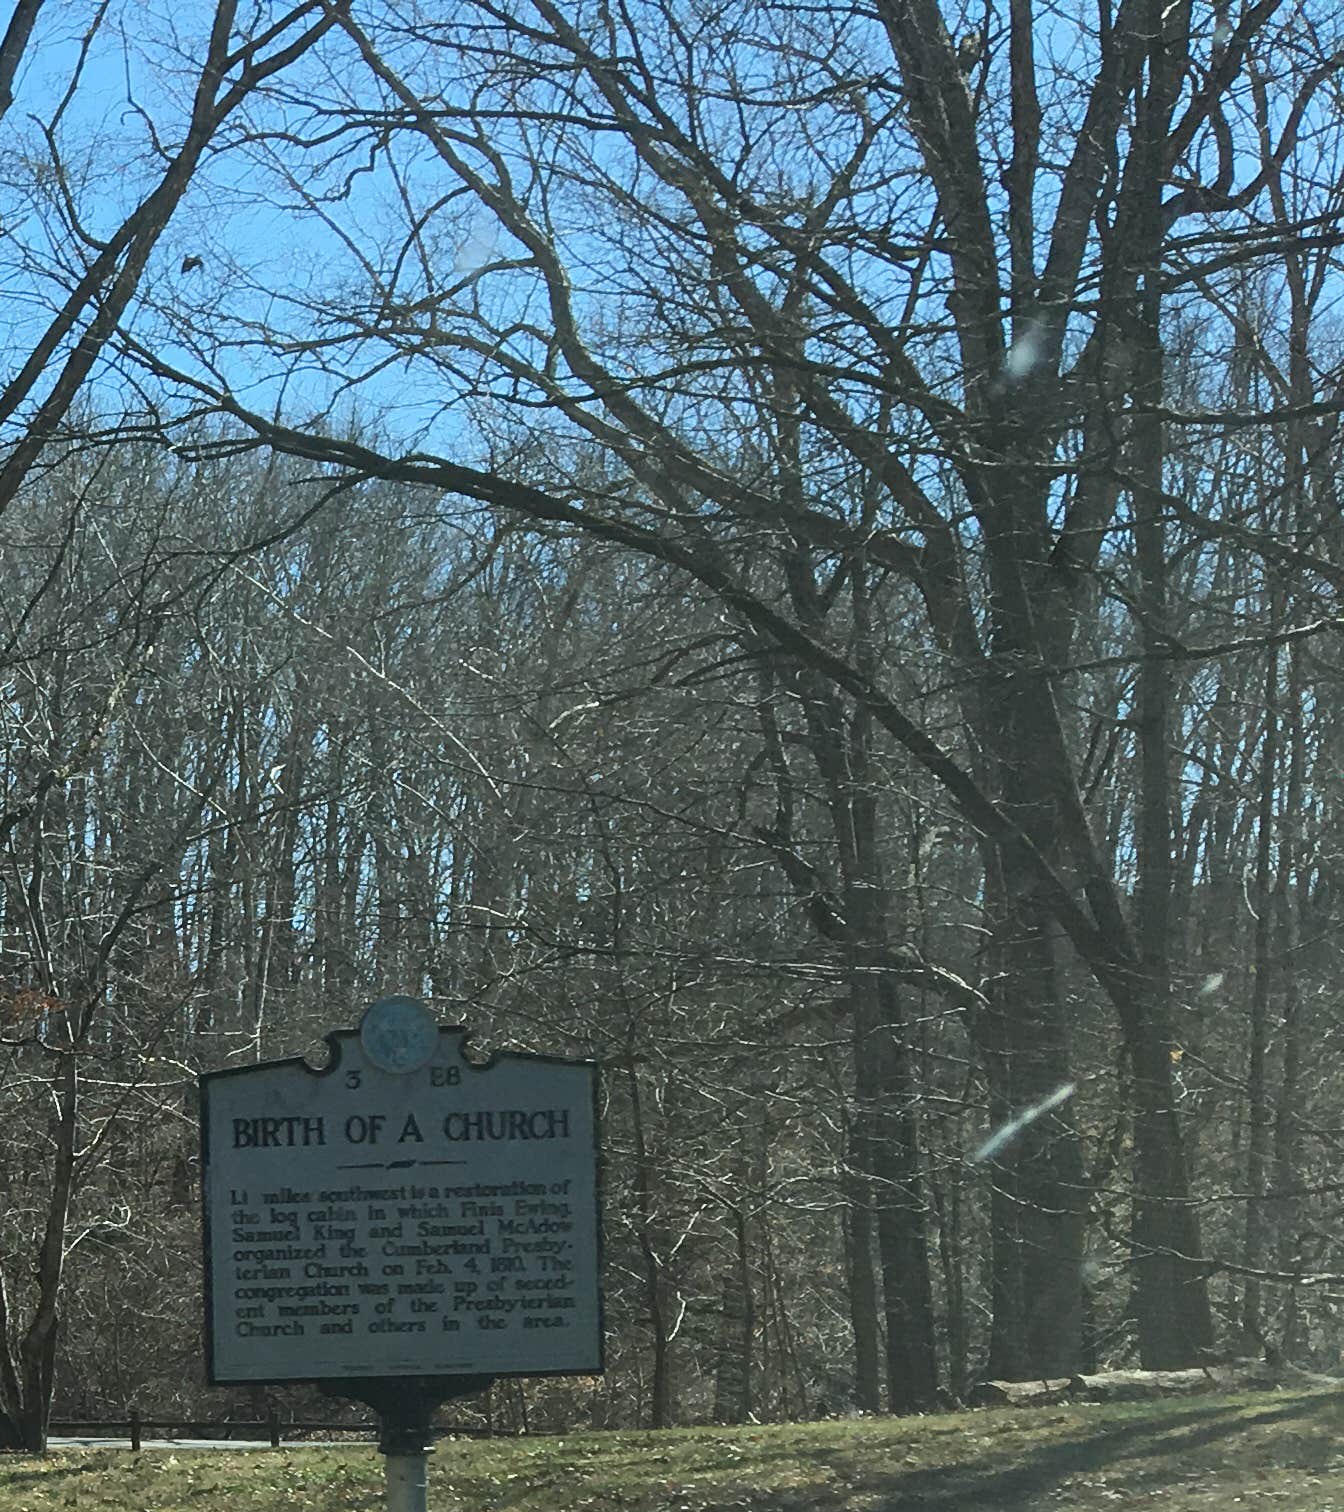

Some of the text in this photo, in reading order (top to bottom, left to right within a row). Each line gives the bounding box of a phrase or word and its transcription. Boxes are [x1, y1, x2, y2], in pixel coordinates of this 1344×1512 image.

[345, 1070, 361, 1089] 3
[231, 1110, 570, 1149] BIRTH OF A CHURCH
[261, 1187, 312, 1204] miles
[318, 1186, 406, 1202] southwest
[411, 1185, 425, 1200] is
[428, 1187, 440, 1199] a
[444, 1181, 547, 1198] restoration
[550, 1179, 571, 1195] of
[231, 1209, 261, 1224] the
[270, 1208, 298, 1227] log
[307, 1206, 358, 1222] cabin
[368, 1205, 386, 1220] in
[397, 1203, 449, 1218] which
[461, 1201, 504, 1217] Finis
[232, 1218, 573, 1245] Samuel King and Samuel McAdow
[234, 1237, 573, 1264] organized the Cumberland Presby-
[235, 1264, 291, 1280] terian
[305, 1262, 369, 1278] Church
[382, 1264, 405, 1276] on
[536, 1255, 572, 1271] The
[234, 1274, 575, 1302] congregation was made up of seced-
[235, 1294, 576, 1319] ent members of the Presbyterian
[236, 1315, 571, 1337] Church and others in the area.
